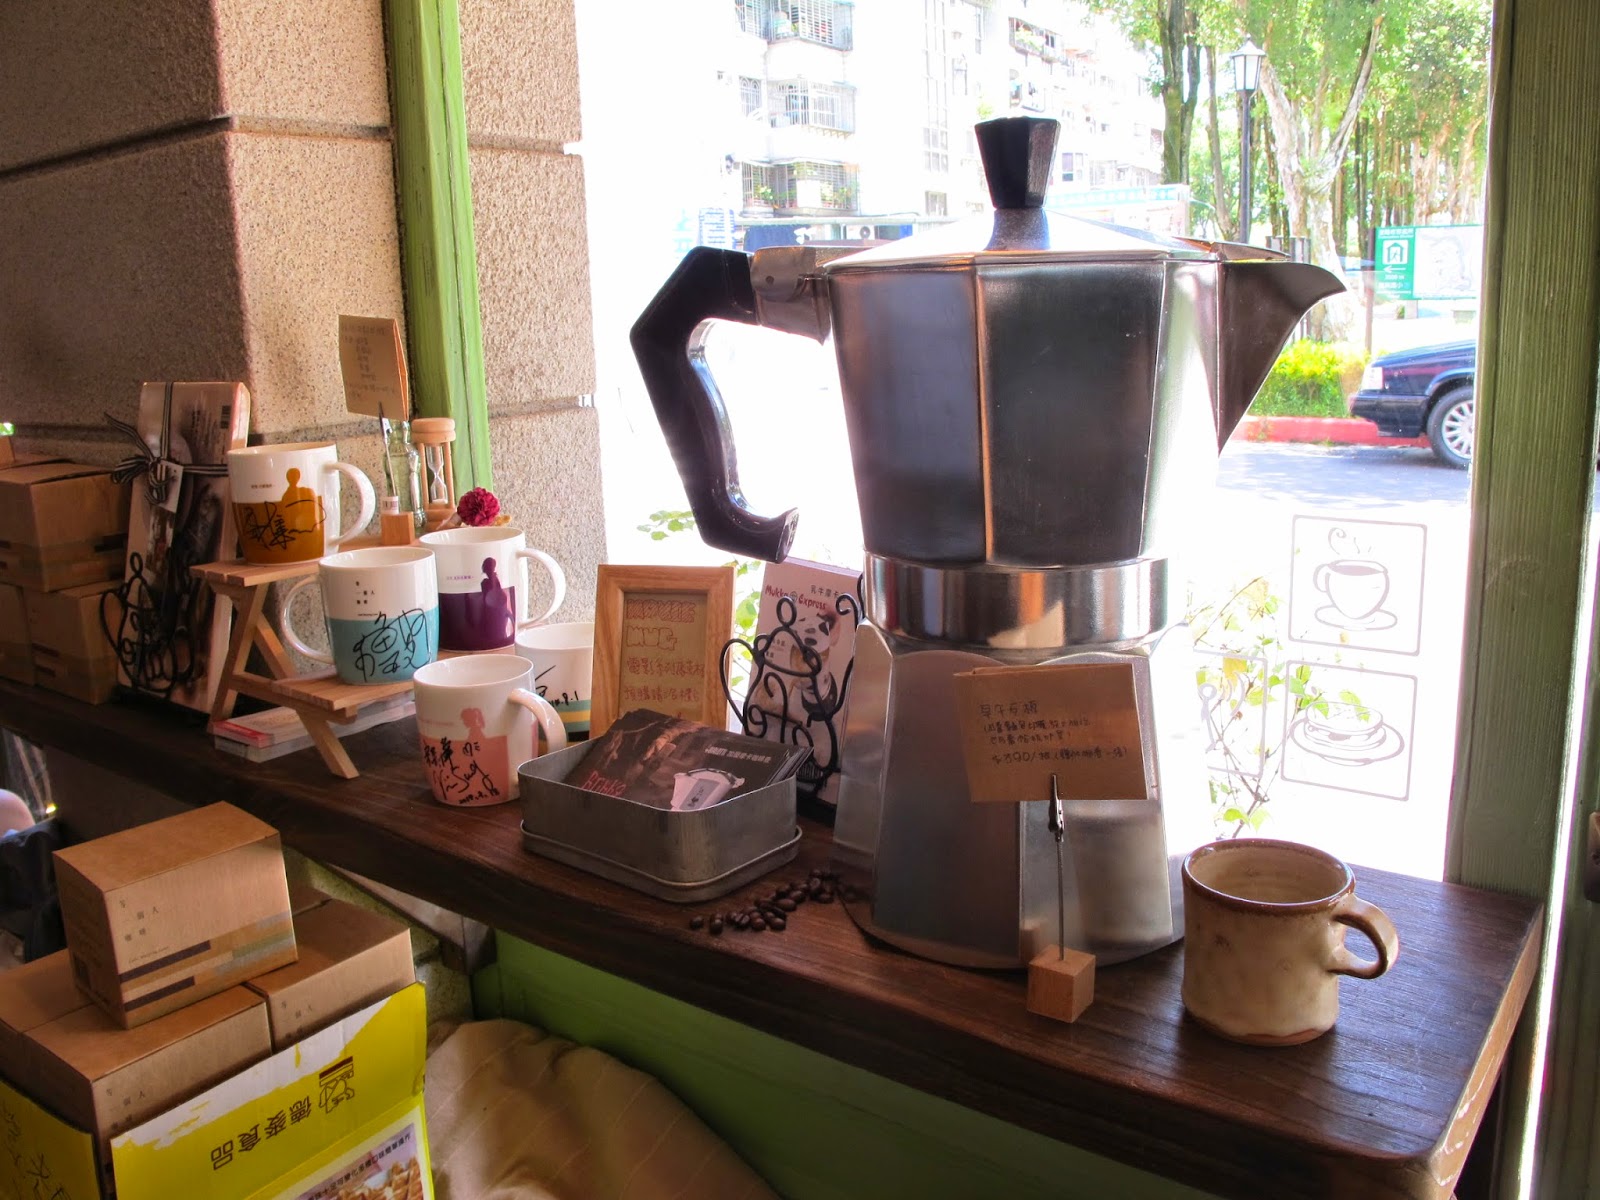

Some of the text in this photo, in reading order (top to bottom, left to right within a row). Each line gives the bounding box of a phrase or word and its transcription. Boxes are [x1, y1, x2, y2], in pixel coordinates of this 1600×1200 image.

[798, 594, 827, 610] Express
[626, 625, 678, 651] MUG
[210, 1094, 312, 1171] 德麥食品
